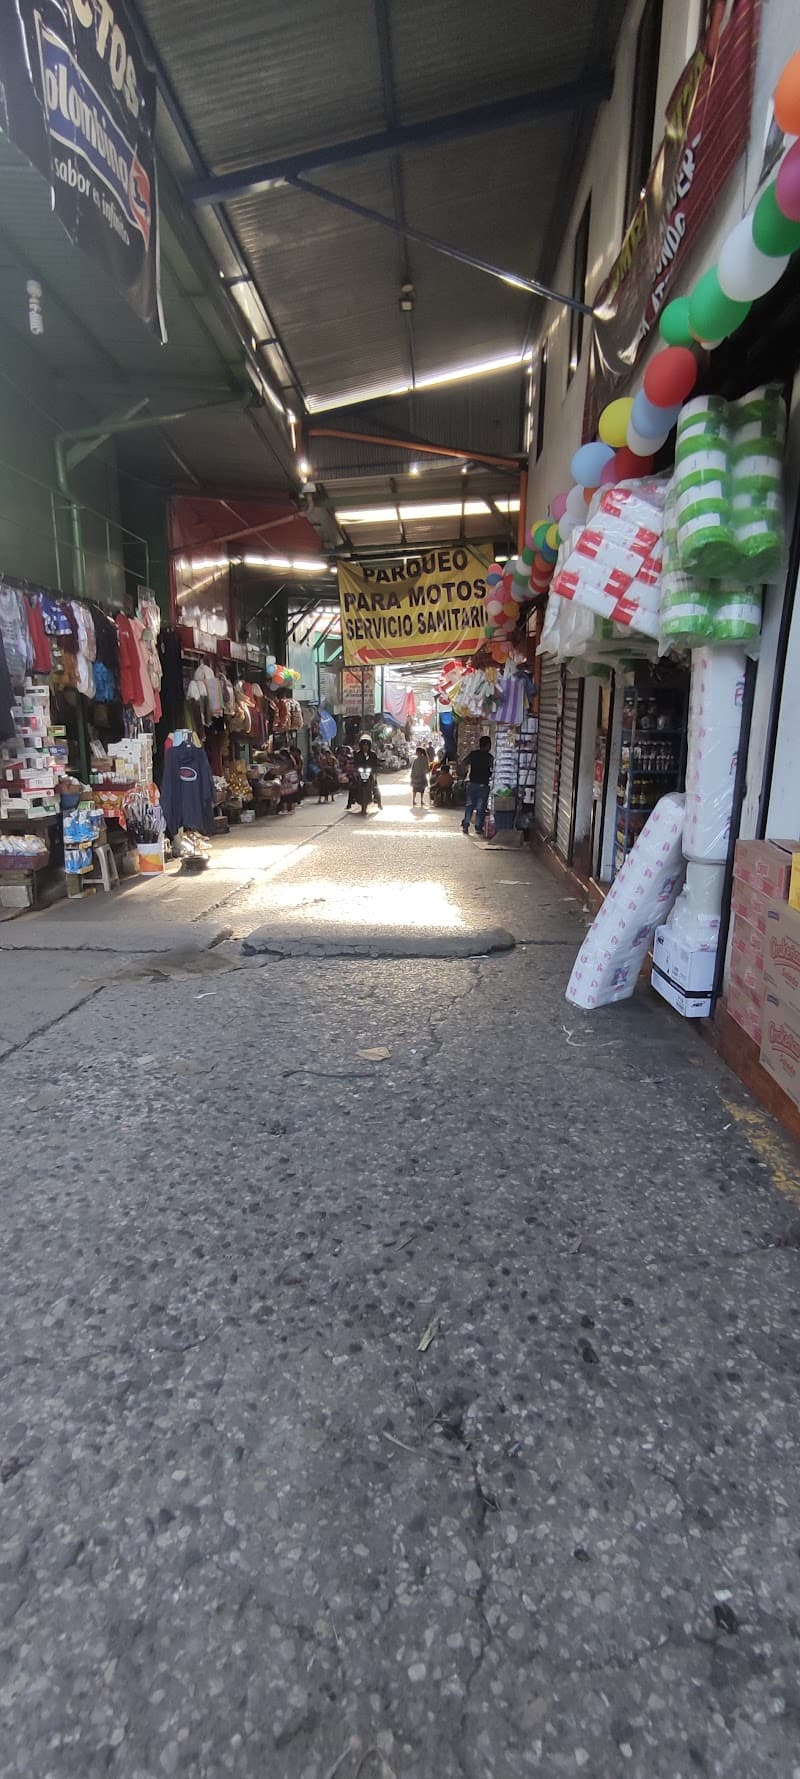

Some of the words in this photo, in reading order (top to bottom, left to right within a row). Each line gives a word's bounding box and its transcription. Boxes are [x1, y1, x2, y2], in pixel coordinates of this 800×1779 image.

[54, 157, 91, 198] sabor
[363, 549, 468, 584] PARQUEO
[344, 592, 401, 613] PARA
[408, 578, 487, 608] MOTOS
[345, 614, 413, 641] SERVICIO
